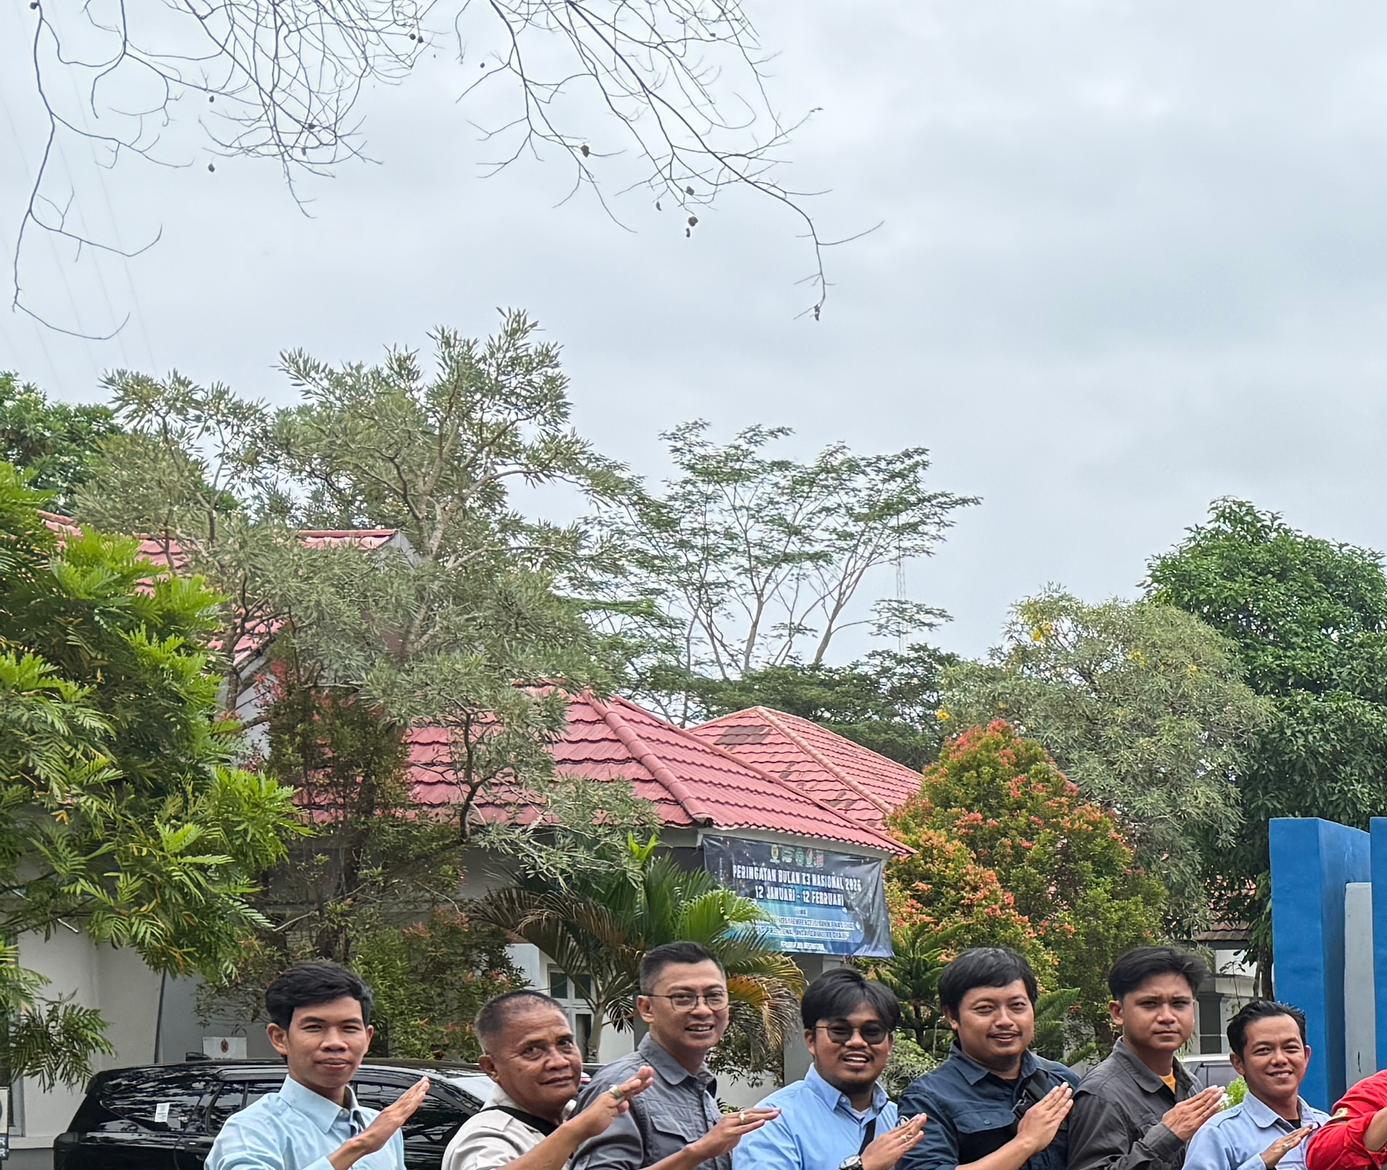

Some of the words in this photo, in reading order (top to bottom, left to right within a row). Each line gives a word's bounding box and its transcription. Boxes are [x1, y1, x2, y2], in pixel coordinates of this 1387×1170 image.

[732, 865, 777, 882] PERINGATAN
[811, 874, 844, 889] NASIONAL
[755, 885, 764, 899] 12
[766, 886, 796, 902] JANUARI
[811, 891, 844, 906] FEBRUARI
